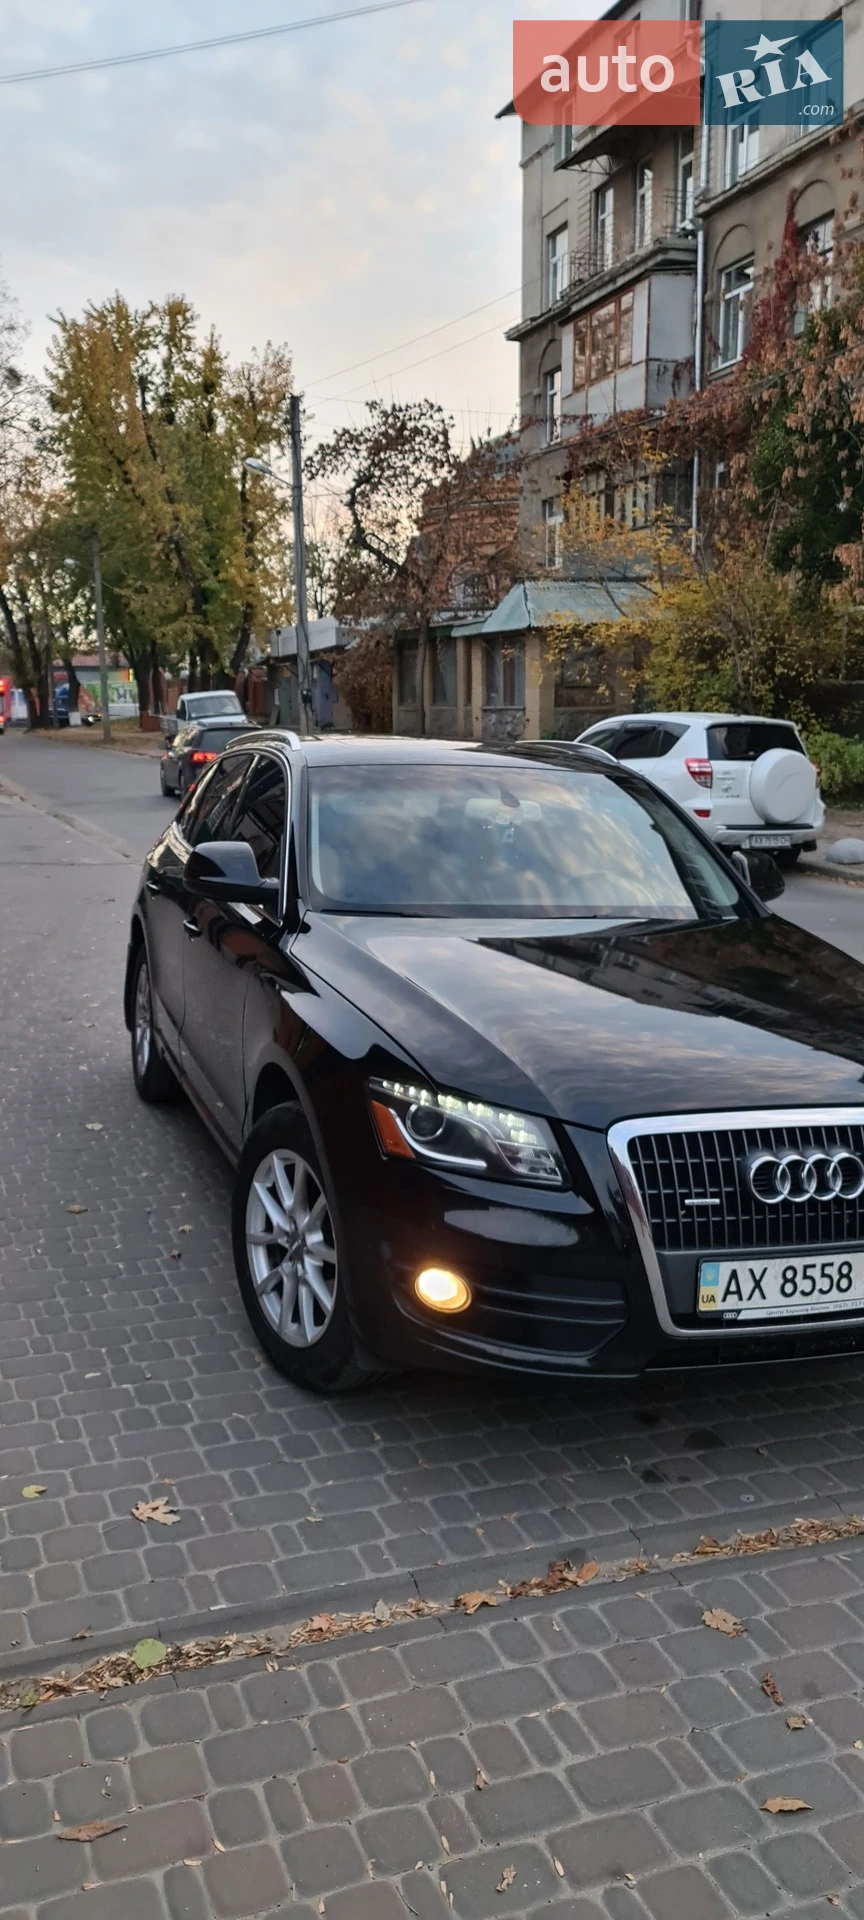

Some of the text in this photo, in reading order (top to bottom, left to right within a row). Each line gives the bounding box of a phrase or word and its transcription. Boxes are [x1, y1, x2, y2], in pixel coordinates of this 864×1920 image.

[721, 1261, 853, 1302] AX 8558
[701, 1294, 716, 1303] UA
